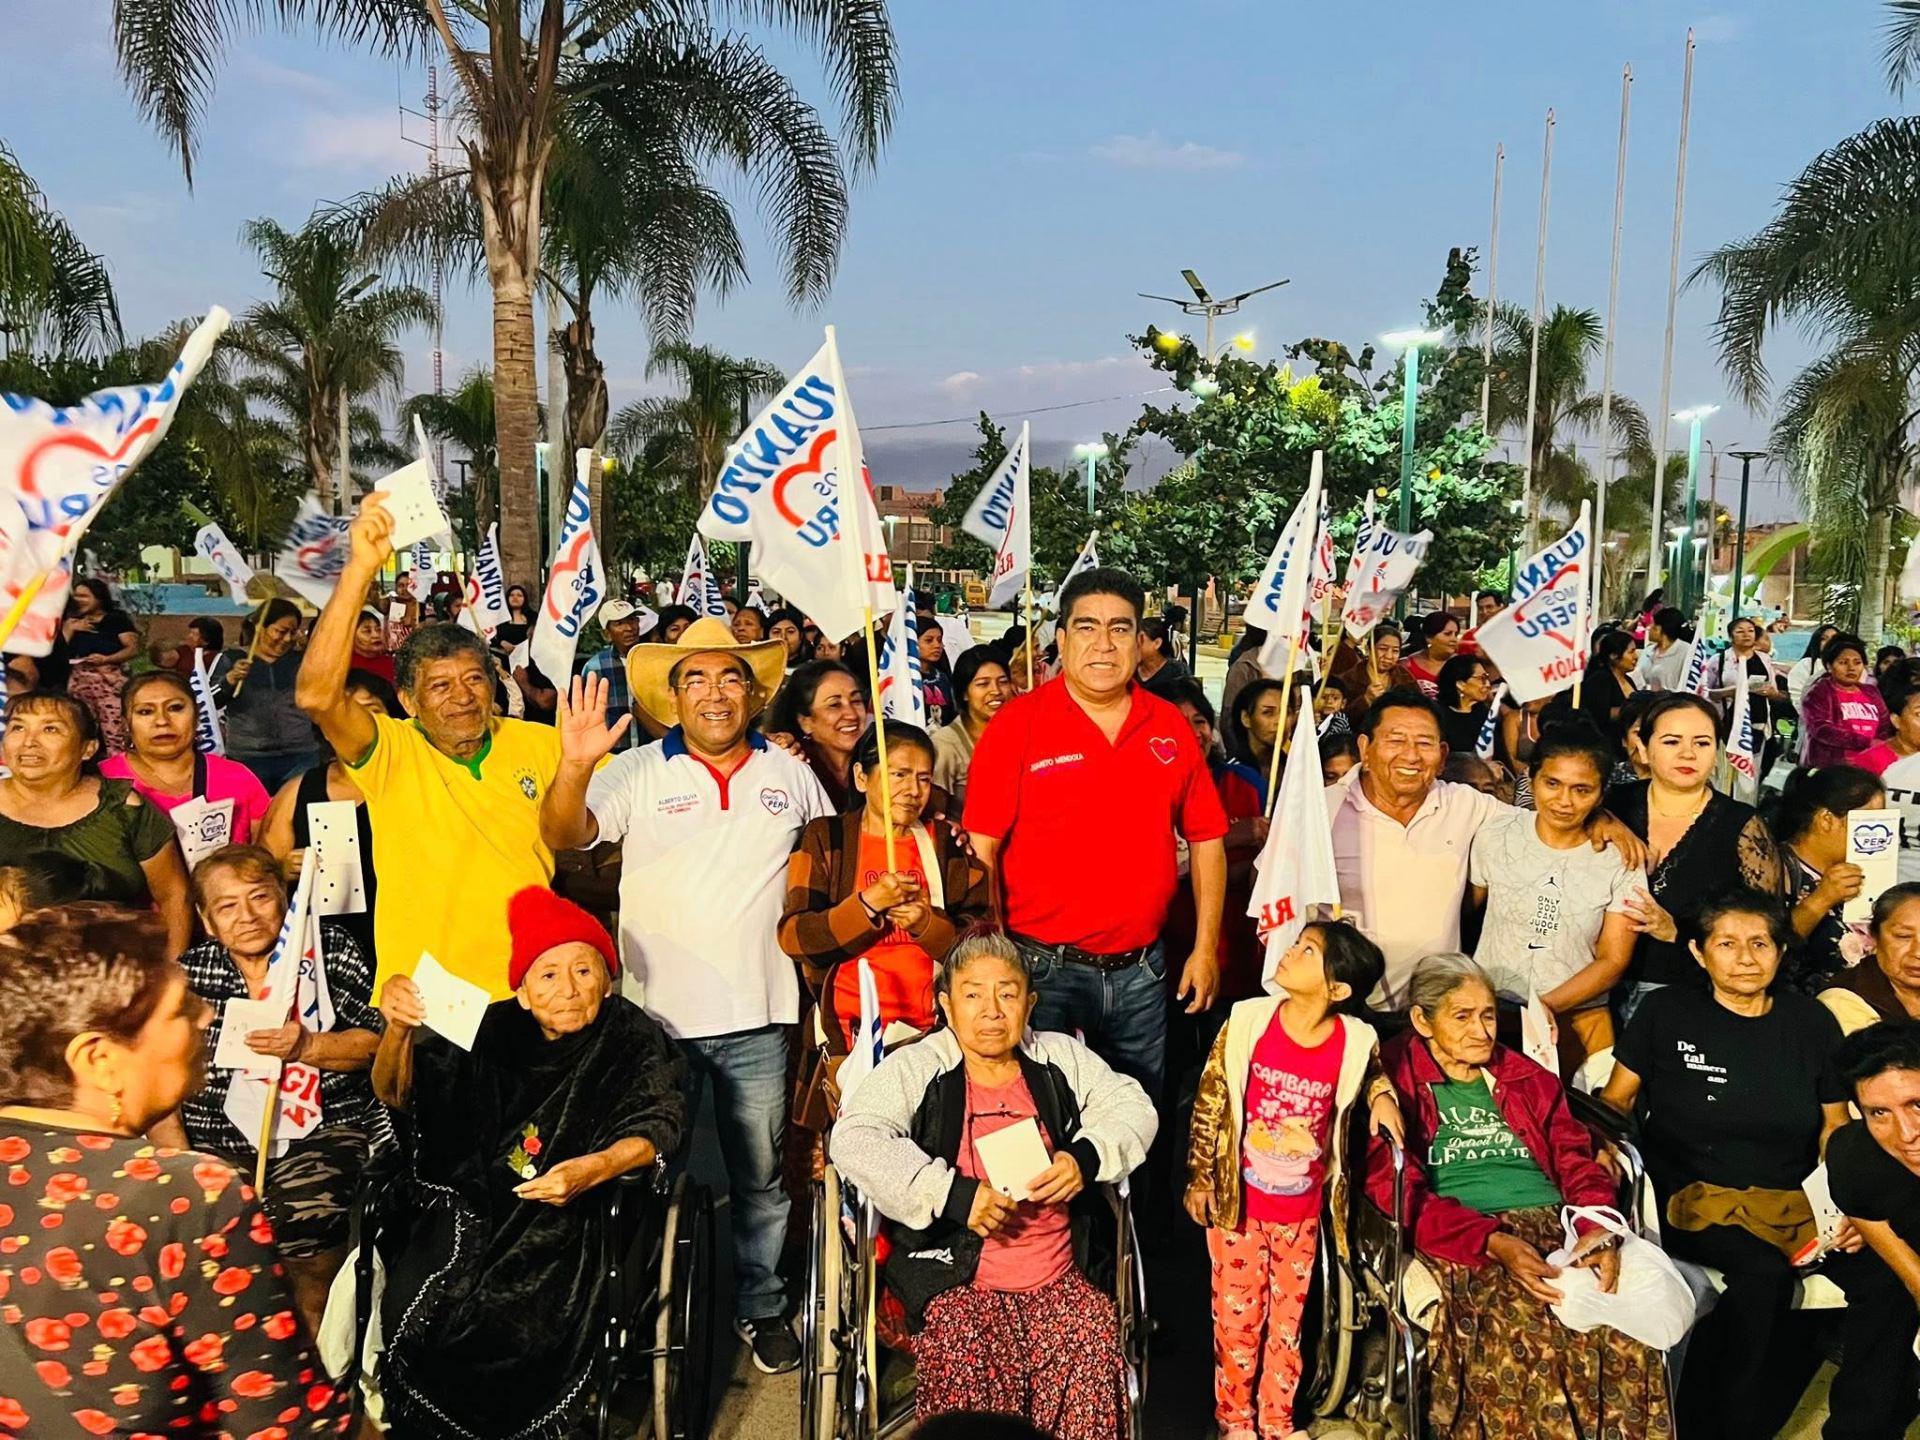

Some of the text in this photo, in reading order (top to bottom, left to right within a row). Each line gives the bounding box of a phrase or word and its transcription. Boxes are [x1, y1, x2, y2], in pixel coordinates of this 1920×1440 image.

[1537, 895, 1560, 906] ONLY
[1537, 902, 1557, 913] GOD
[1536, 910, 1554, 921] CAN
[1530, 918, 1559, 931] JUDGE
[1535, 927, 1548, 936] ME
[1677, 1040, 1696, 1053] De
[1683, 1053, 1705, 1065] tal
[1686, 1062, 1727, 1074] manera
[1252, 1062, 1332, 1098] CAPIBARA
